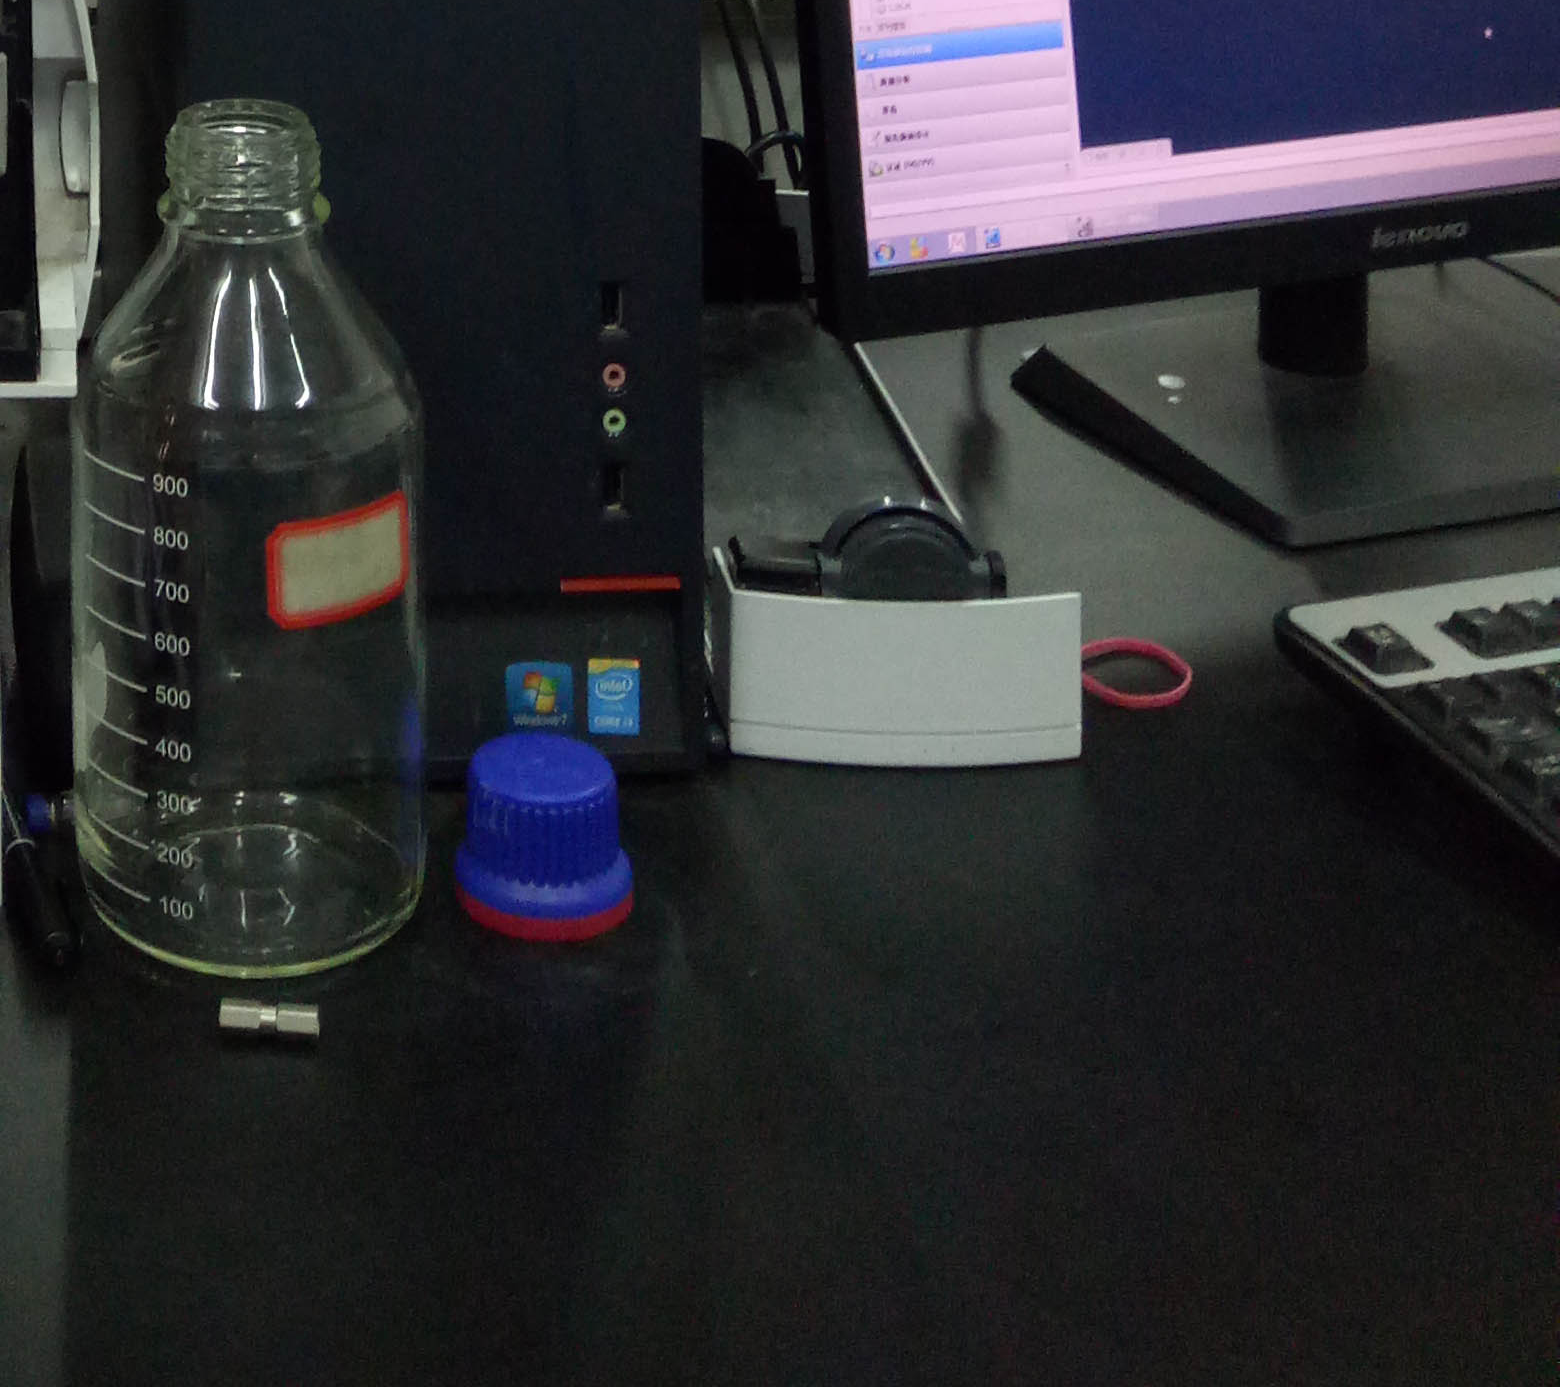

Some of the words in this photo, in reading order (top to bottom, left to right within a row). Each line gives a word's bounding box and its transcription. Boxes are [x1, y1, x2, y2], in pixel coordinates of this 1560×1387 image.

[153, 473, 188, 497] 900
[154, 527, 188, 551] 800
[154, 580, 189, 604] 700
[154, 632, 190, 658] 600
[155, 686, 191, 710] 500
[156, 739, 191, 762] 400
[159, 897, 193, 920] 100
